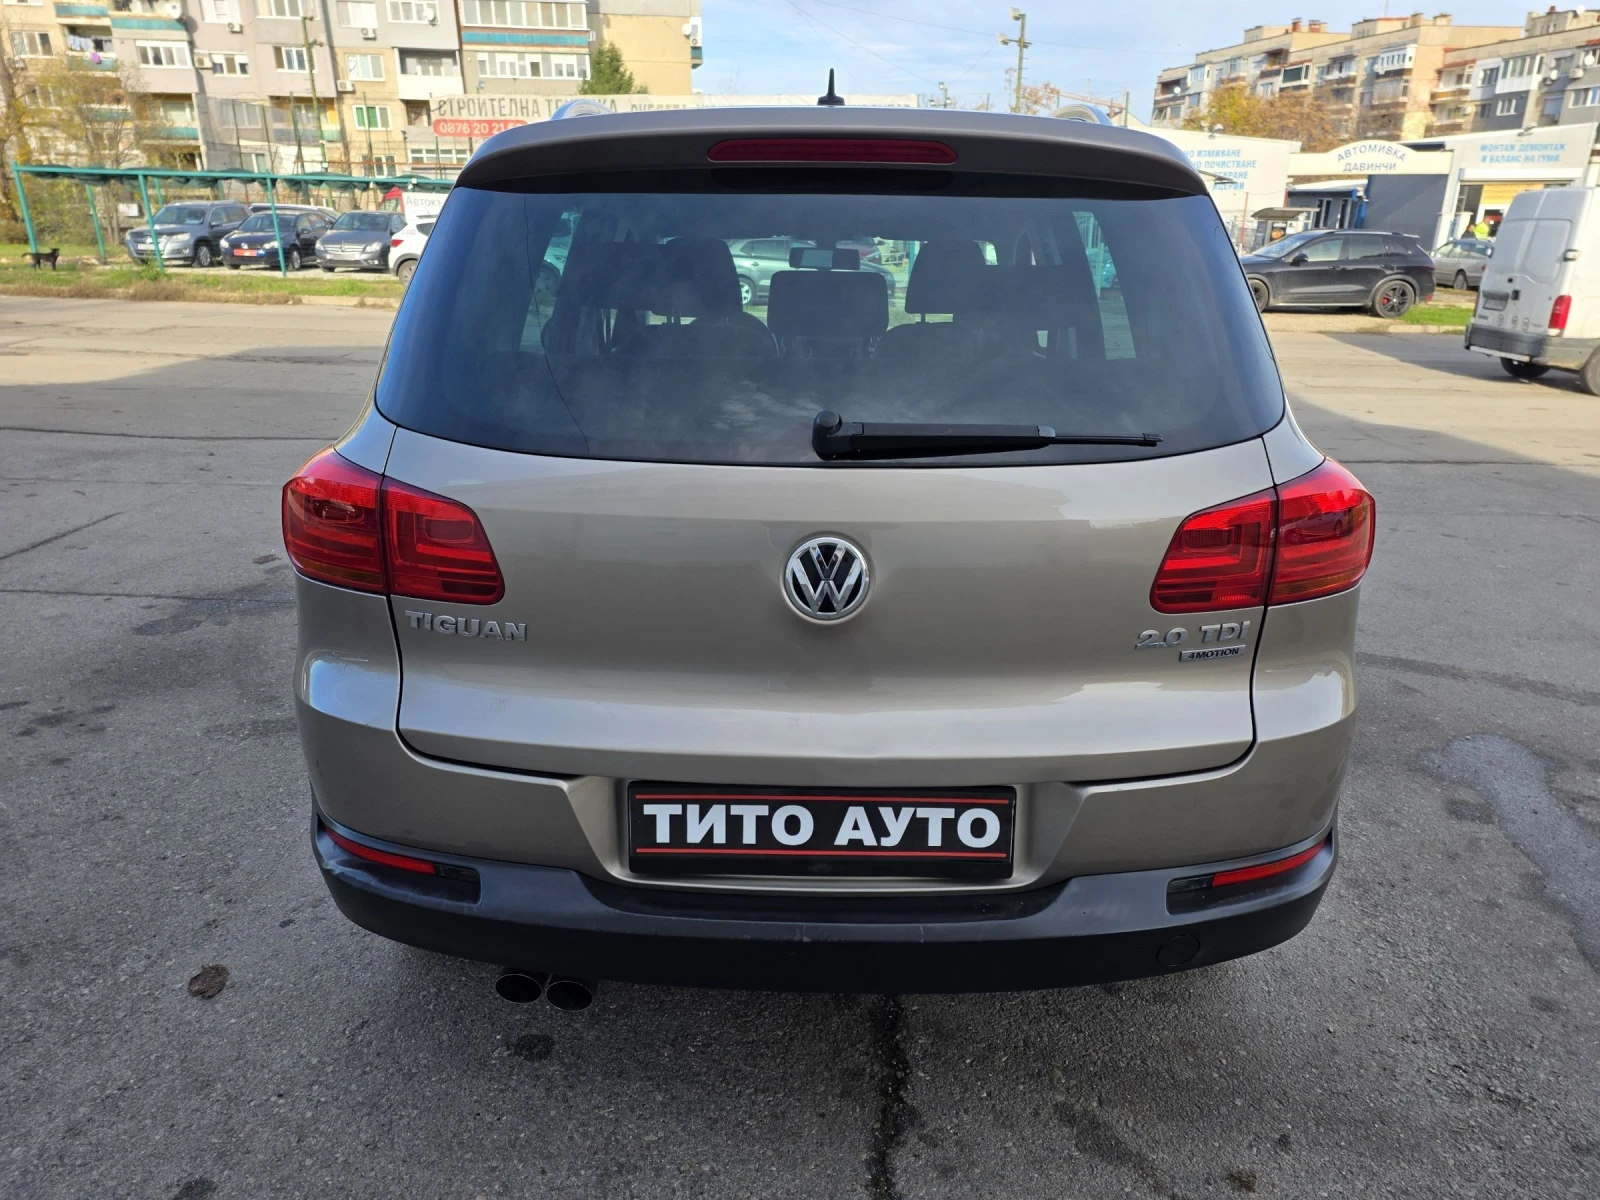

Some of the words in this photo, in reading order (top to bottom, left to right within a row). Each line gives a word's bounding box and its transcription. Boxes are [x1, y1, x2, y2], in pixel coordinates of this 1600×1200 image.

[438, 98, 541, 117] СТРОИТЕЛНА
[440, 122, 471, 134] 0876
[473, 122, 489, 134] 20
[1197, 149, 1241, 158] ИЗМИВАНЕ
[1337, 144, 1406, 162] АВТОМИВКА
[1204, 160, 1257, 169] ПОЧИСТВАНЕ
[1343, 162, 1397, 172] ДАВИНЧИ
[405, 610, 527, 641] TIGUAN
[1199, 620, 1251, 643] TDI
[1188, 647, 1240, 660] 4MOTION
[643, 803, 814, 845] ТИТО
[834, 806, 1000, 848] АУТО
